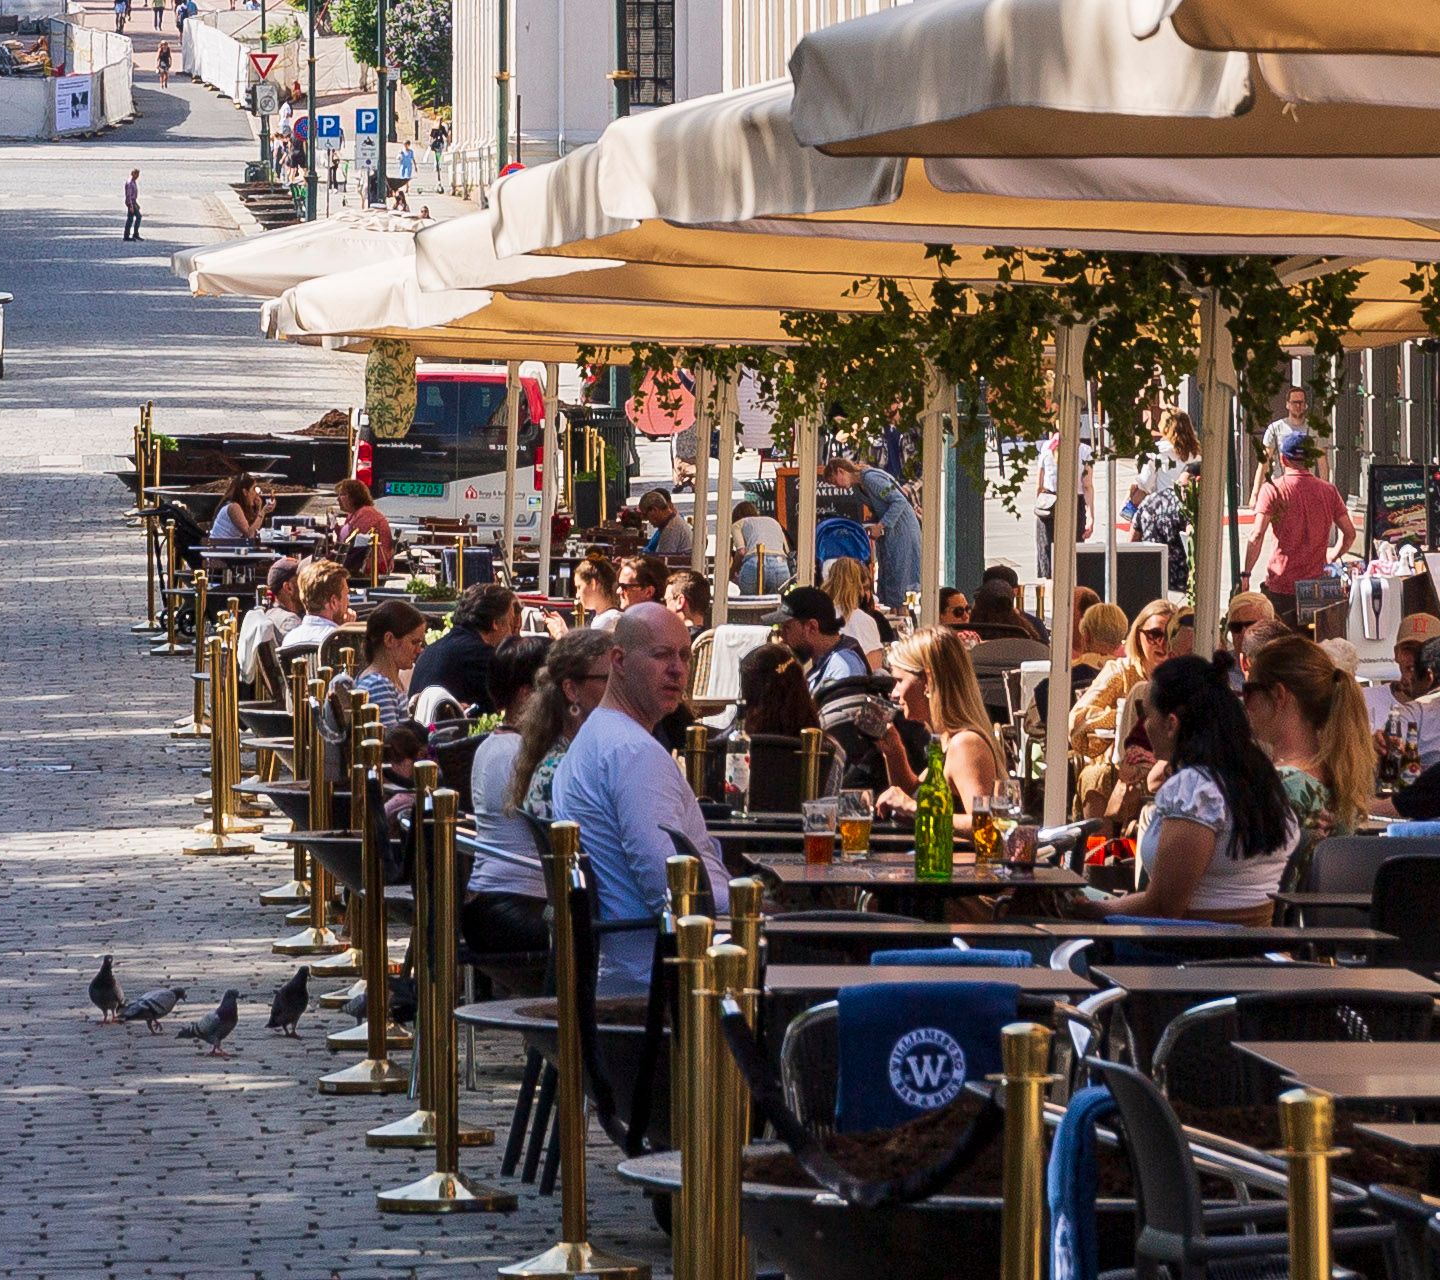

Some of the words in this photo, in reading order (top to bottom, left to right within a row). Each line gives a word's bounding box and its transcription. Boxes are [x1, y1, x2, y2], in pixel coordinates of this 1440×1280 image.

[323, 118, 335, 135] P
[361, 111, 375, 131] P
[394, 484, 406, 493] EC
[410, 484, 439, 495] 27705
[816, 487, 854, 496] AKERIES
[906, 1055, 948, 1088] W
